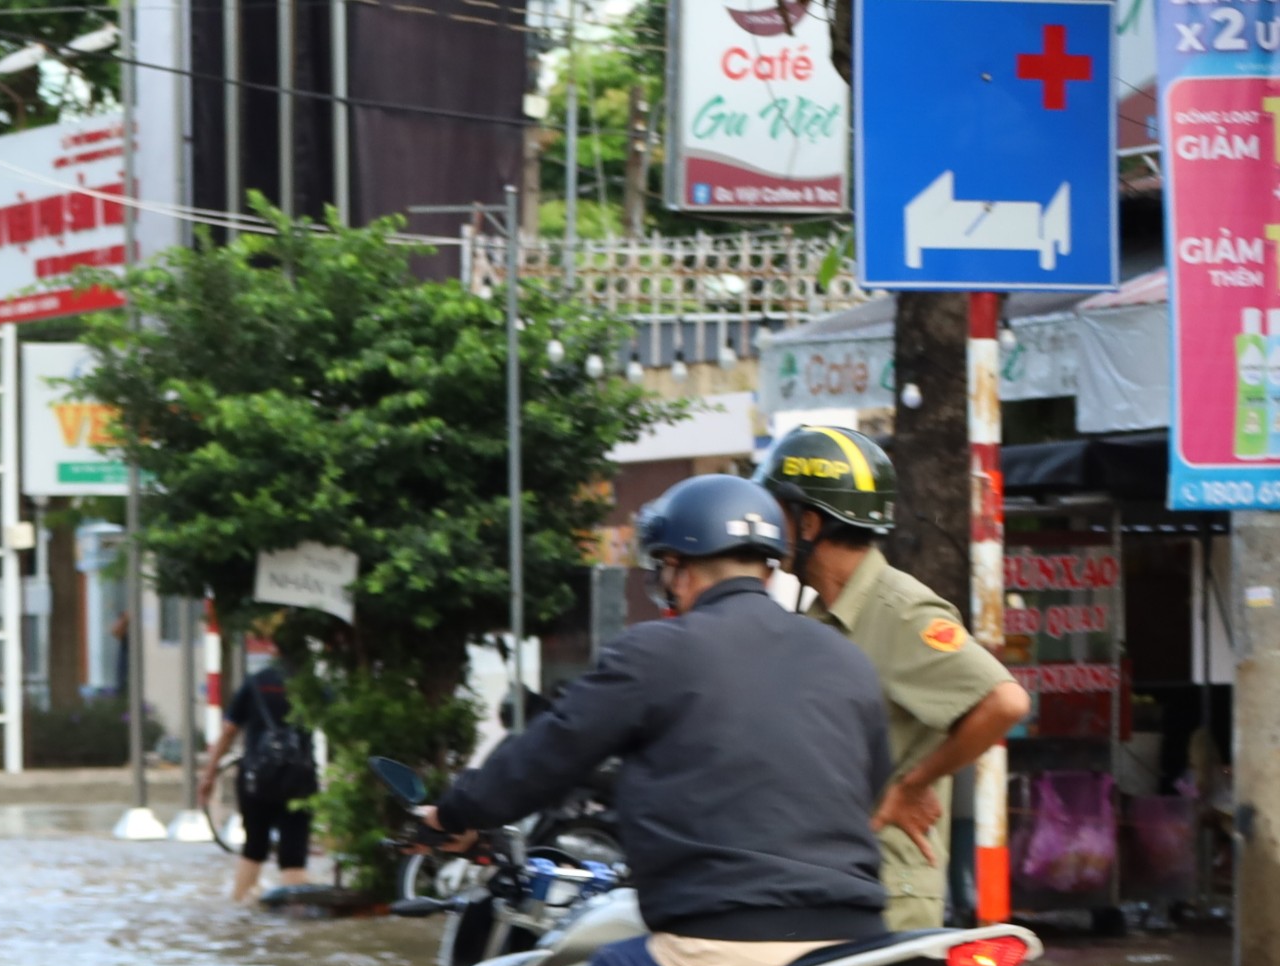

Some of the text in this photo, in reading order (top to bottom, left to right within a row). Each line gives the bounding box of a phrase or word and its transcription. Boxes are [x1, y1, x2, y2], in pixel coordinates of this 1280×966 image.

[720, 45, 813, 81] Café
[1176, 126, 1261, 161] GIẢM
[1179, 227, 1265, 265] GIẢM
